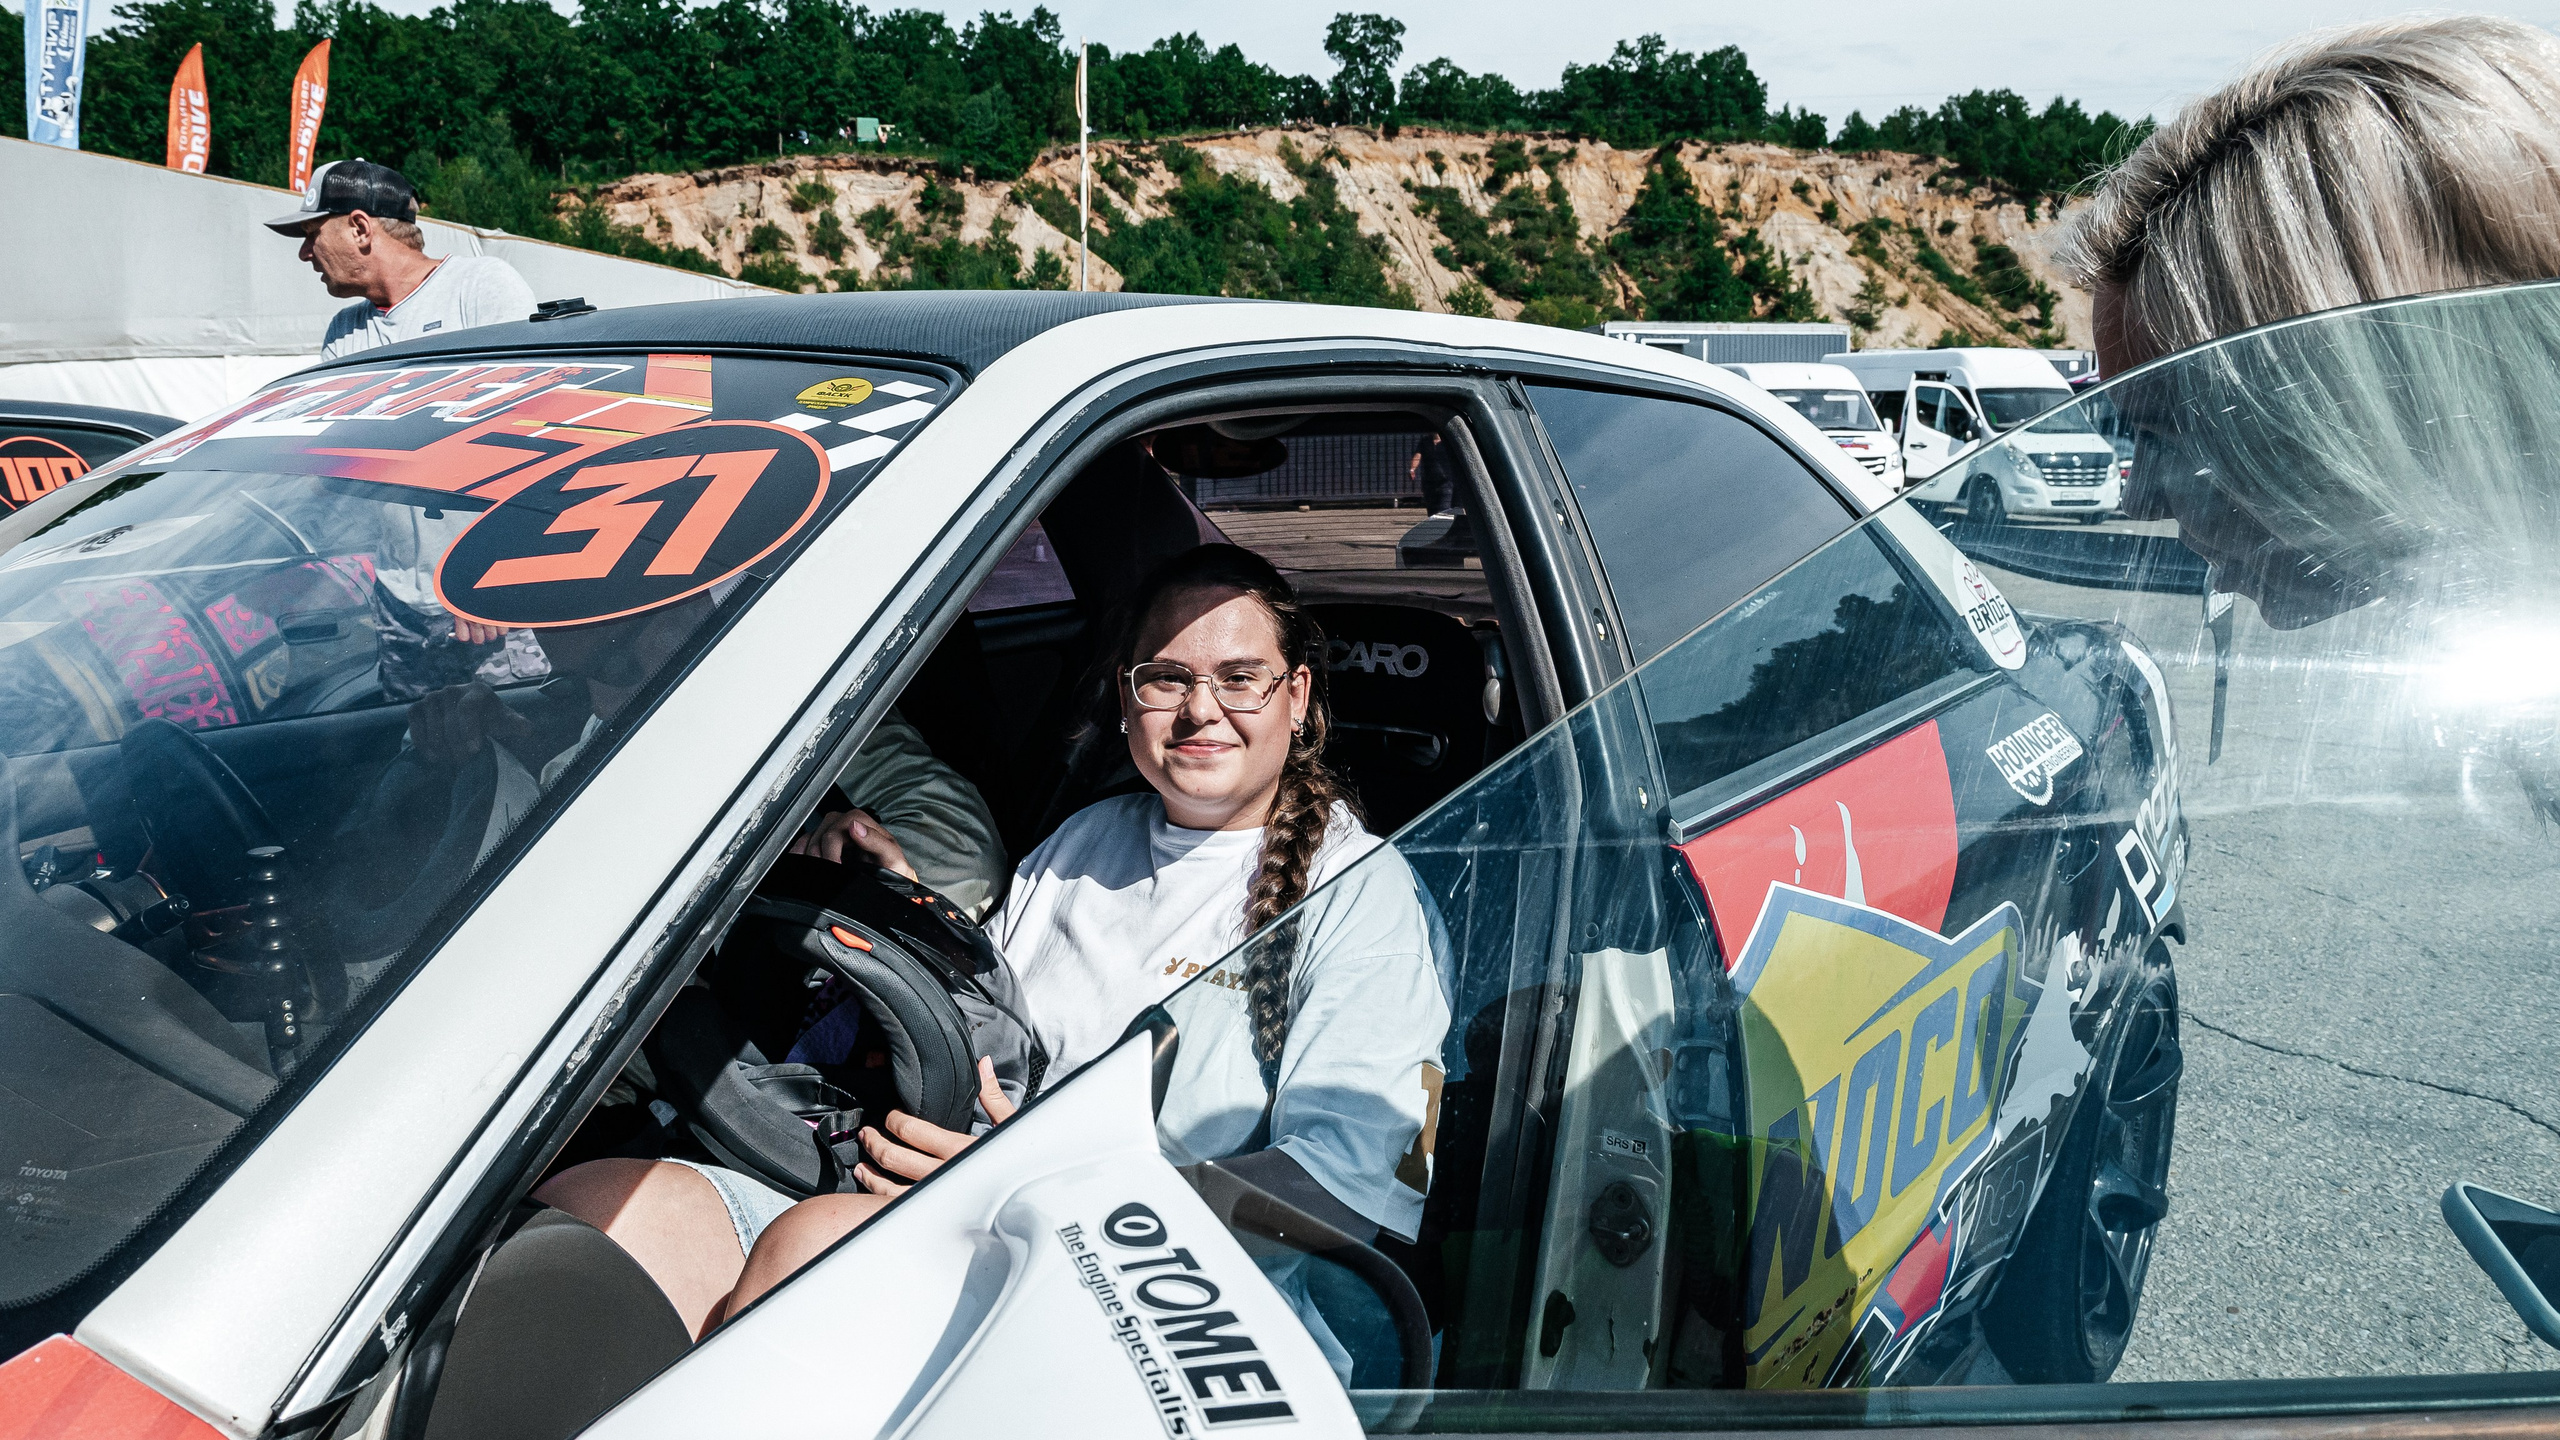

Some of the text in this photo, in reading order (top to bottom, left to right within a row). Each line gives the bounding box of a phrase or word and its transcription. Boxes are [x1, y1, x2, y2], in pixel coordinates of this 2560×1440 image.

[40, 10, 59, 96] ТУРНИР
[473, 449, 779, 588] 31
[1969, 595, 2010, 633] BRIDE
[1990, 716, 2070, 778] HOLINGER
[2044, 740, 2081, 772] ENGINEERING
[1606, 1135, 1629, 1150] SRS
[19, 1166, 68, 1180] TOYOTA
[1060, 1221, 1193, 1440] The Engine Specialis
